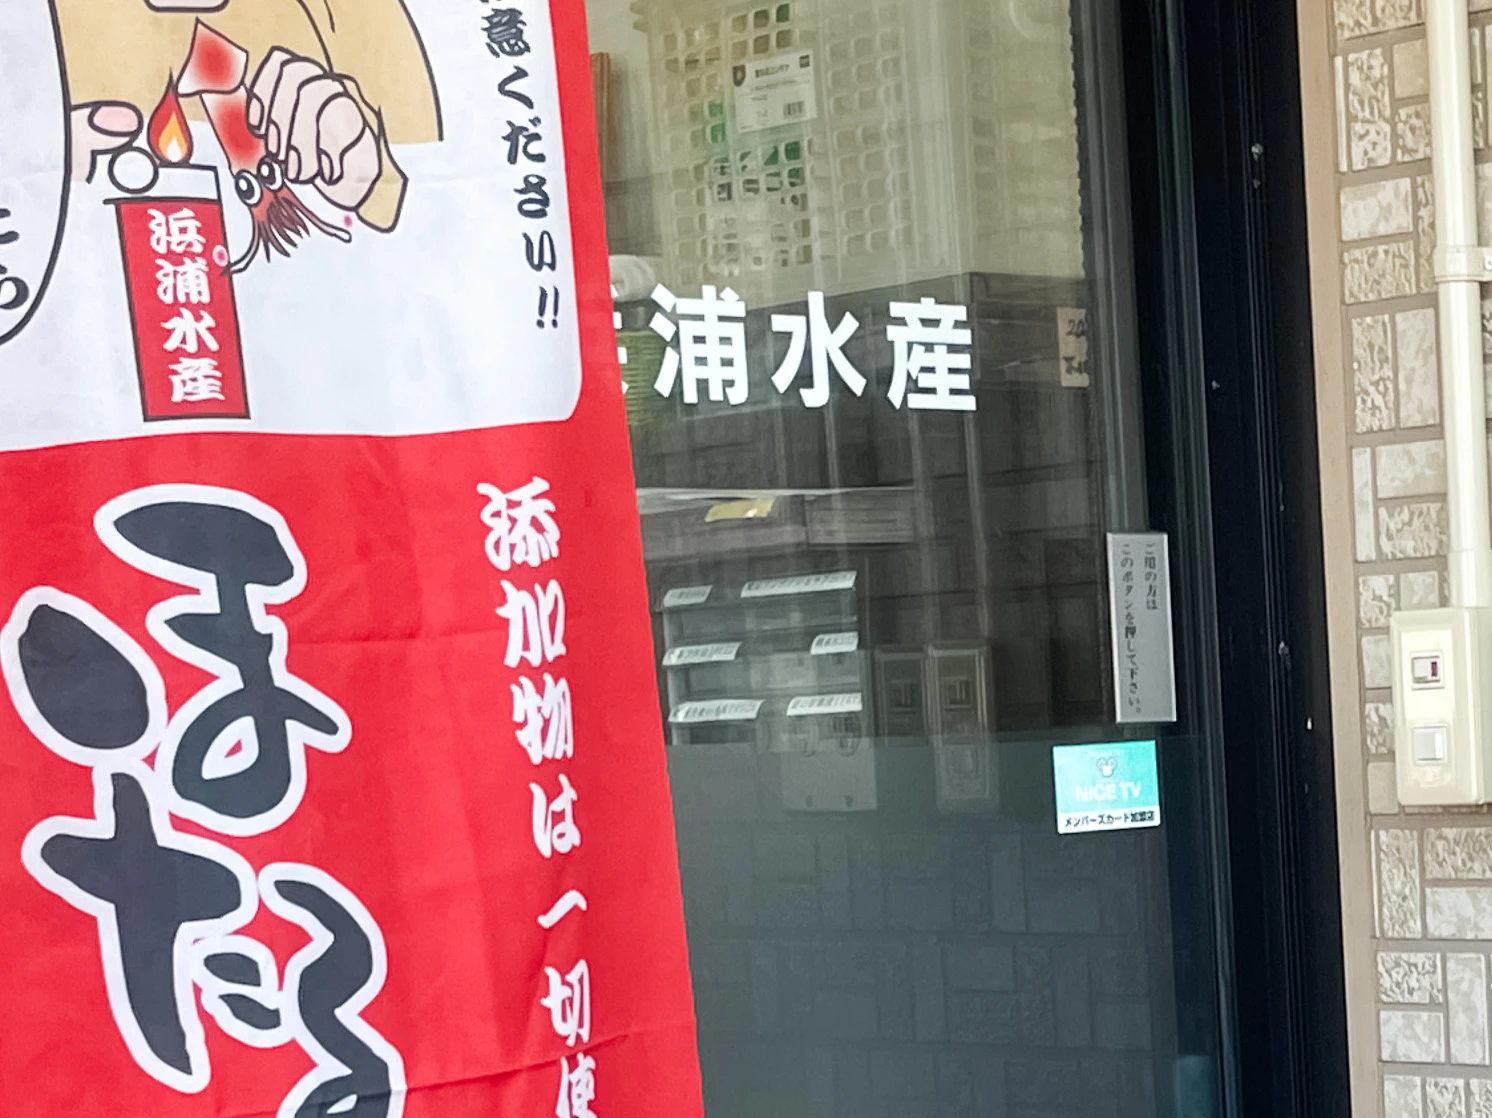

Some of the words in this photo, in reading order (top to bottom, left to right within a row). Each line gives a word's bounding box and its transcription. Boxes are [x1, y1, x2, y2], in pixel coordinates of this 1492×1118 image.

[480, 0, 559, 329] 意ください!!
[148, 208, 226, 404] 浜浦水産
[611, 284, 977, 411] 浦水産
[1076, 783, 1117, 803] NICE
[1119, 780, 1142, 801] TV
